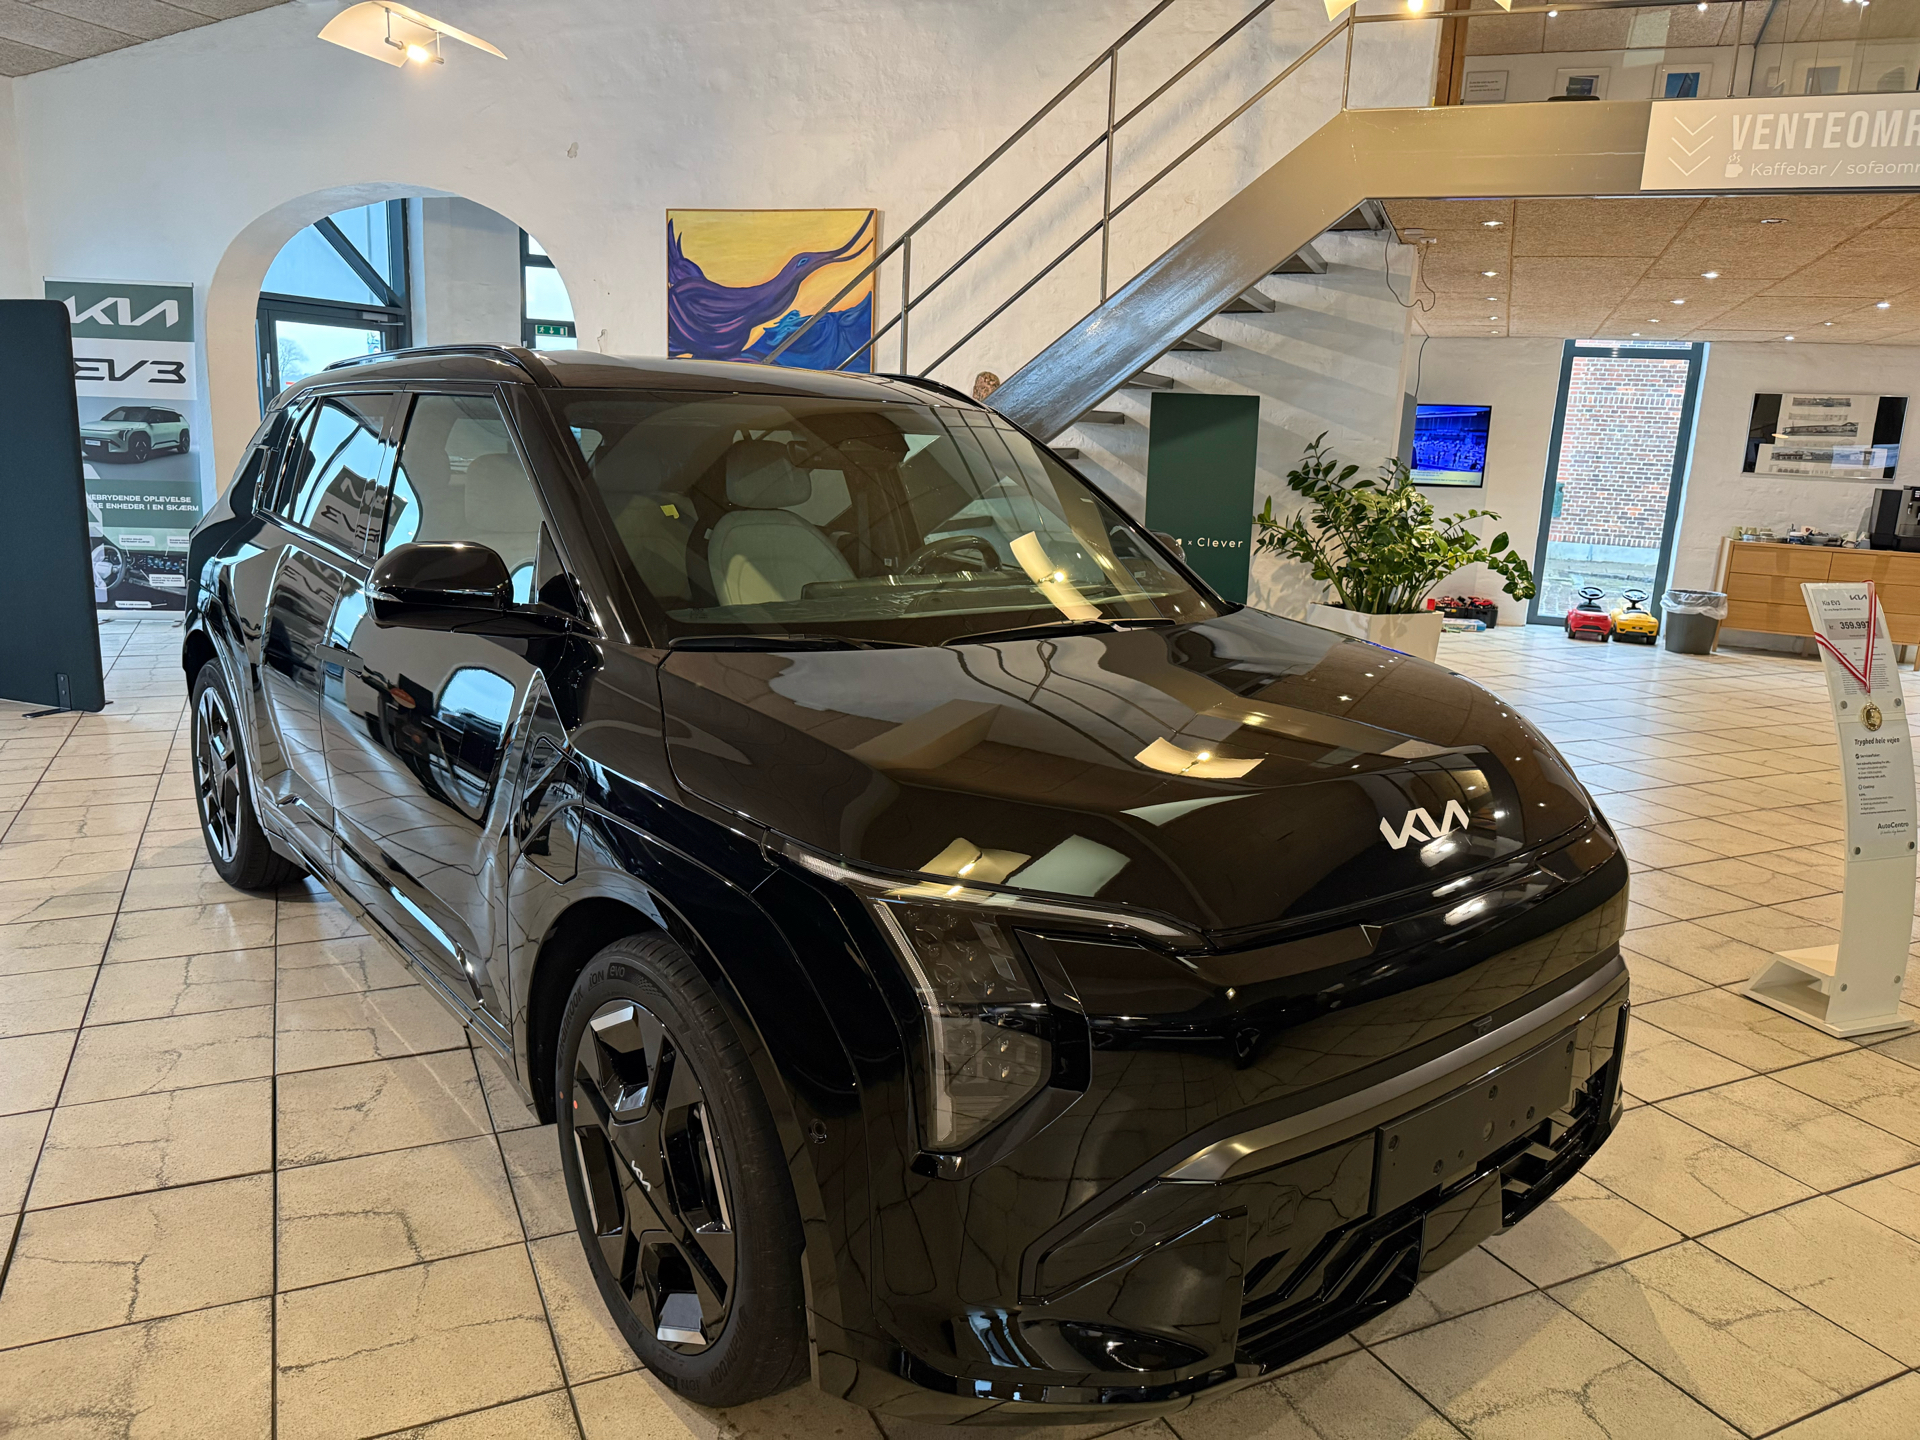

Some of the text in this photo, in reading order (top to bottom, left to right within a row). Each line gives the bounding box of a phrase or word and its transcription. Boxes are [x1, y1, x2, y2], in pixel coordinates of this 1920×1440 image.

[1732, 109, 1920, 151] VENTEOMR
[1750, 162, 1827, 176] Kaffebar
[62, 295, 179, 328] KIA
[73, 357, 187, 384] EV3
[143, 495, 191, 503] OPLEVELSE
[106, 502, 145, 510] ENHEDER
[166, 504, 199, 512] SKÆRM
[1197, 537, 1243, 548] Clever
[1854, 737, 1875, 747] Tryghed
[1379, 799, 1470, 850] KIA
[1877, 821, 1910, 830] AutoCentro
[609, 965, 626, 978] evo
